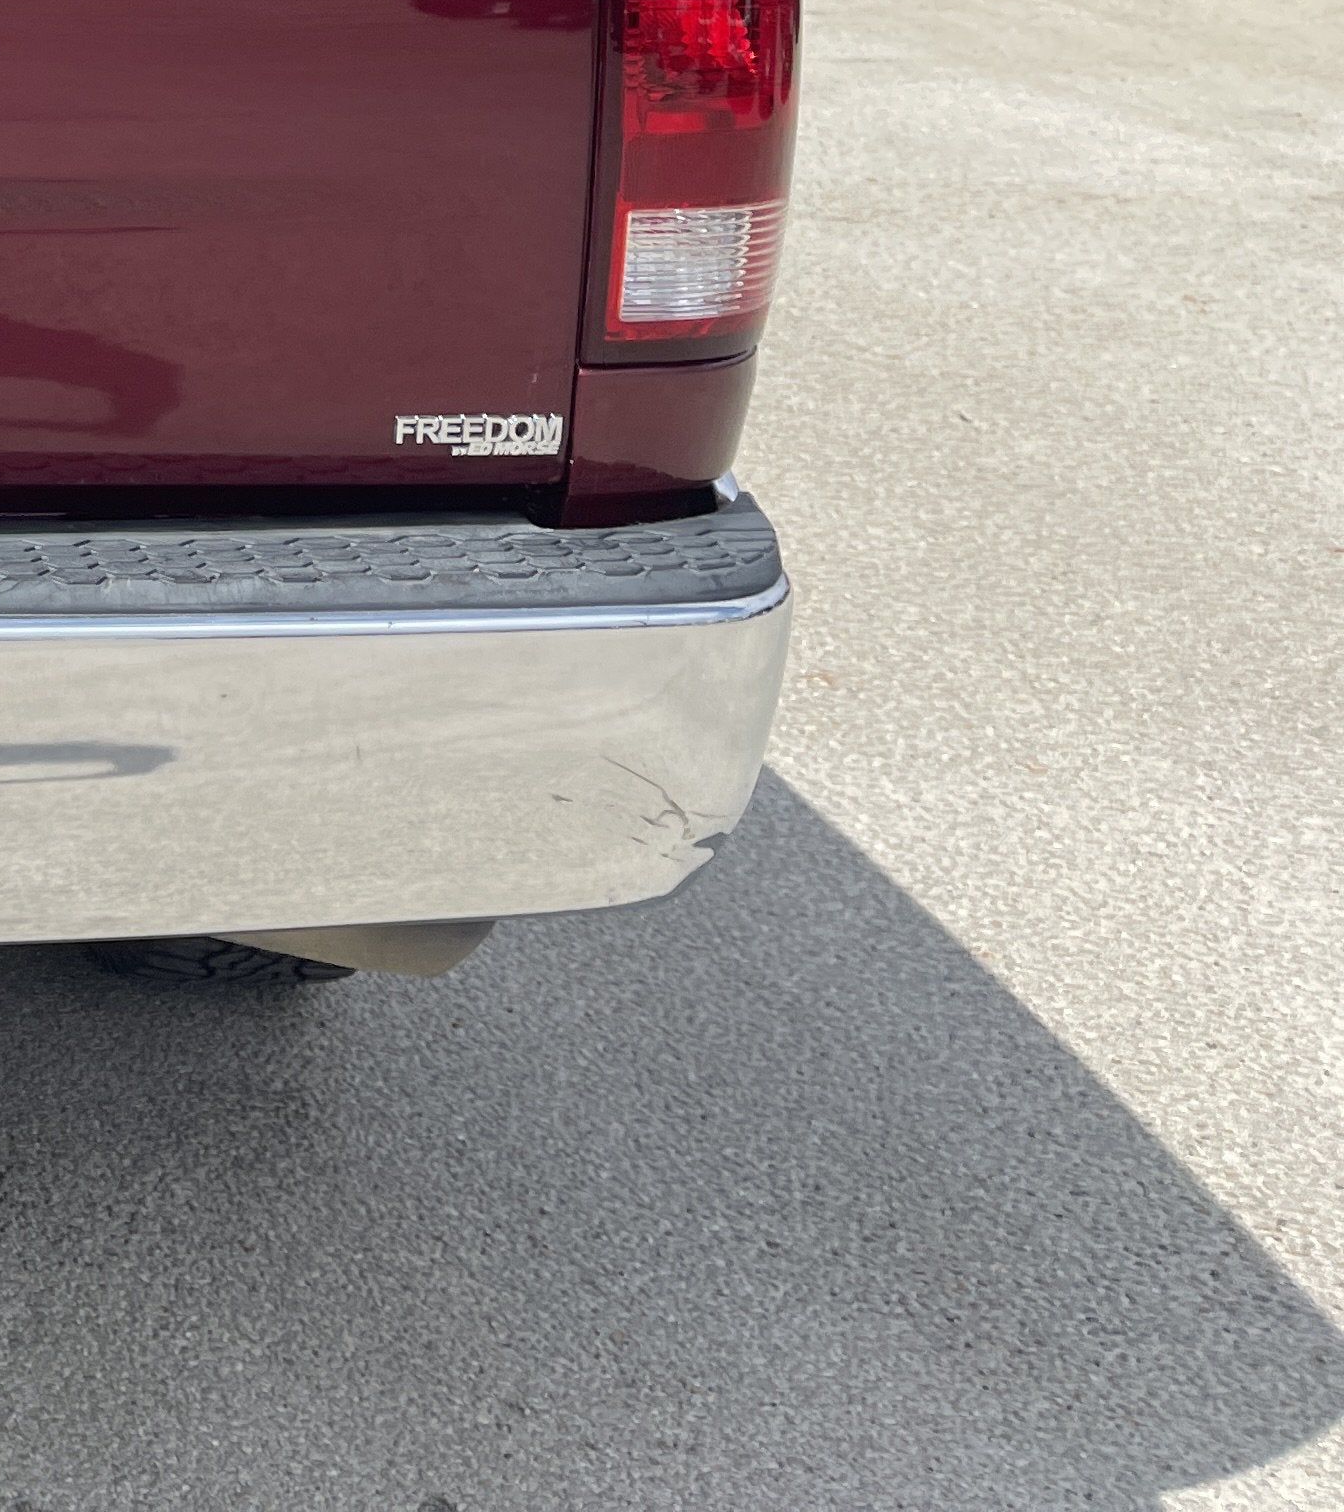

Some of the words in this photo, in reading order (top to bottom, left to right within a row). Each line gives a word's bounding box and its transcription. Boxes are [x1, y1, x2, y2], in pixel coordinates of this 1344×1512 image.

[395, 414, 564, 444] FREEDOM
[467, 442, 493, 456] ED
[493, 441, 560, 456] MORSE
